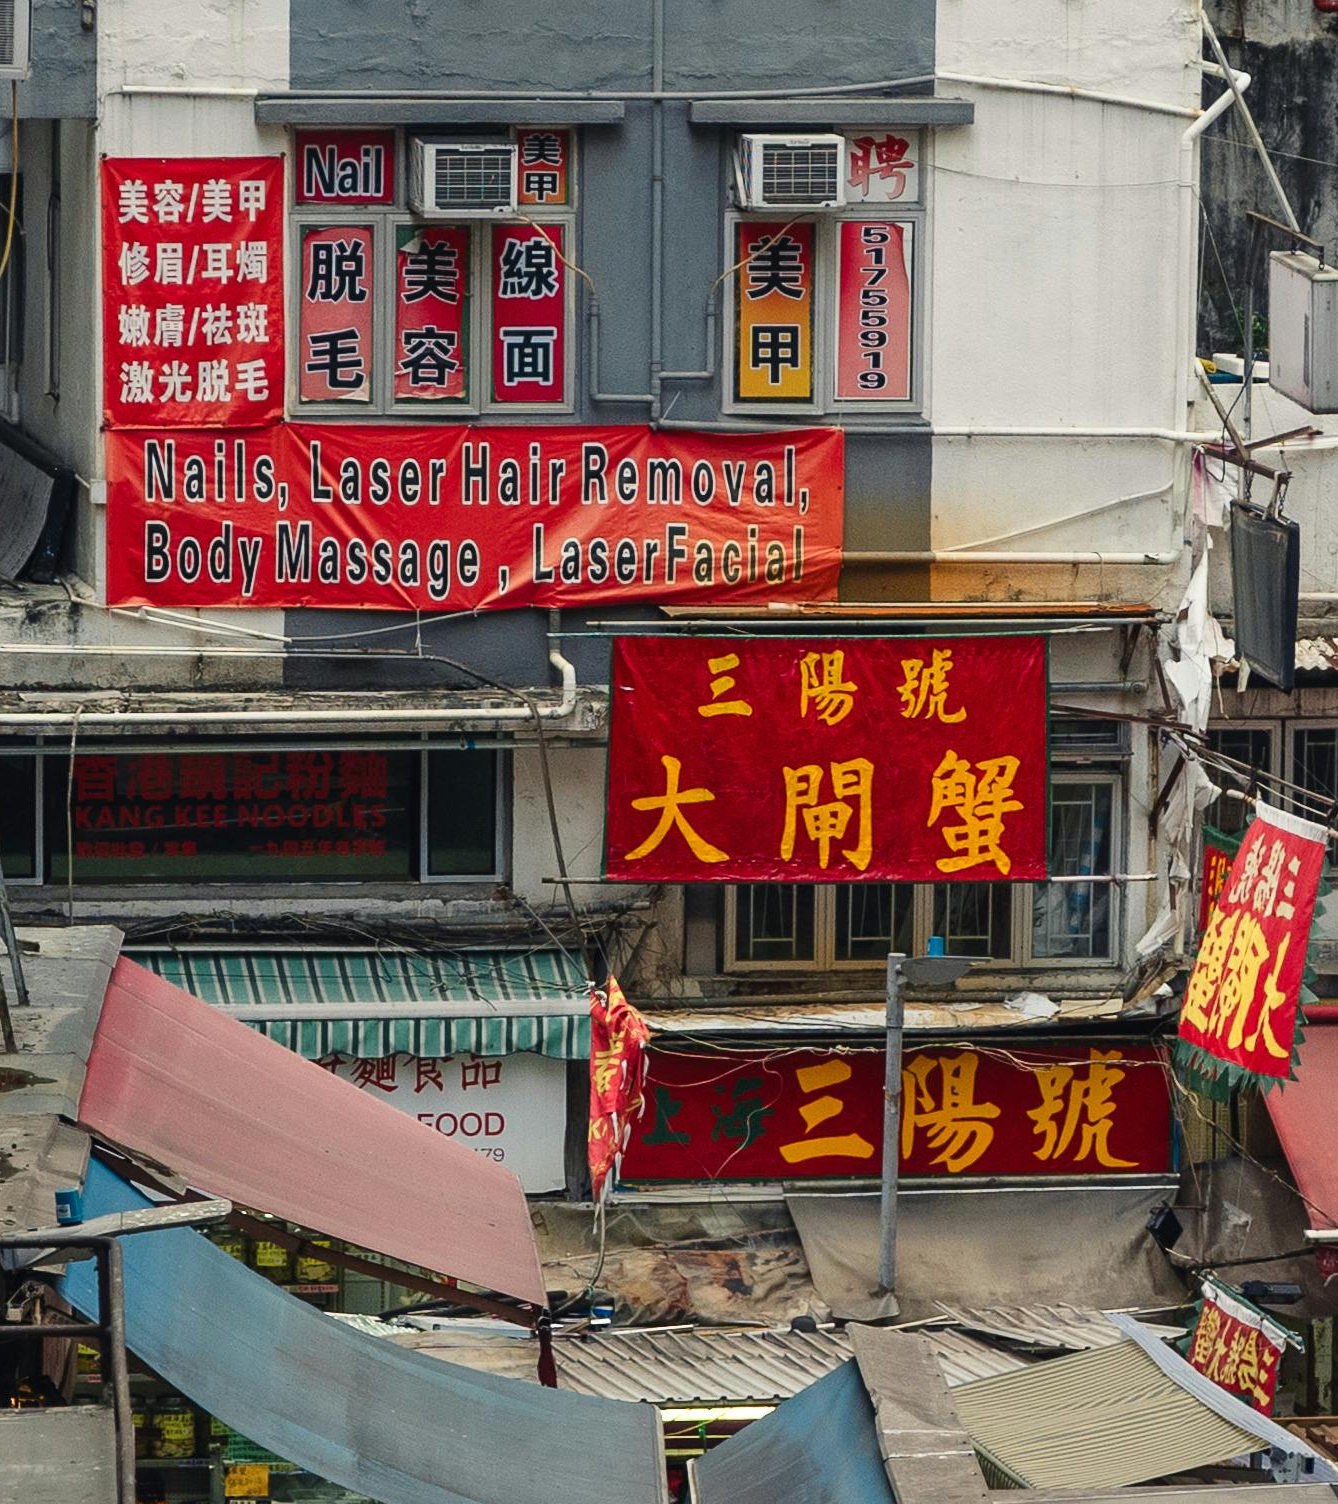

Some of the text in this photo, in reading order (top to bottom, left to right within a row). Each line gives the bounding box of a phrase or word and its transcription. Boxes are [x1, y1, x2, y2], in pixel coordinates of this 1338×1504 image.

[118, 179, 267, 224] 美容/美甲
[303, 143, 385, 199] Nail
[522, 133, 563, 203] 美甲
[846, 133, 915, 202] 聘
[118, 241, 268, 286] 修眉/耳燭
[398, 233, 461, 388] 美容
[497, 238, 559, 388] 線面
[745, 234, 809, 386] 美甲
[858, 224, 892, 392] 51755919
[143, 439, 811, 516] Nails, Laser Hair Removal,
[143, 520, 264, 597] Body
[275, 521, 481, 602] Massage
[696, 647, 968, 727] 三陽號
[75, 803, 388, 829] KANG KEE NOODLES
[624, 748, 1027, 877] 大閘蟹
